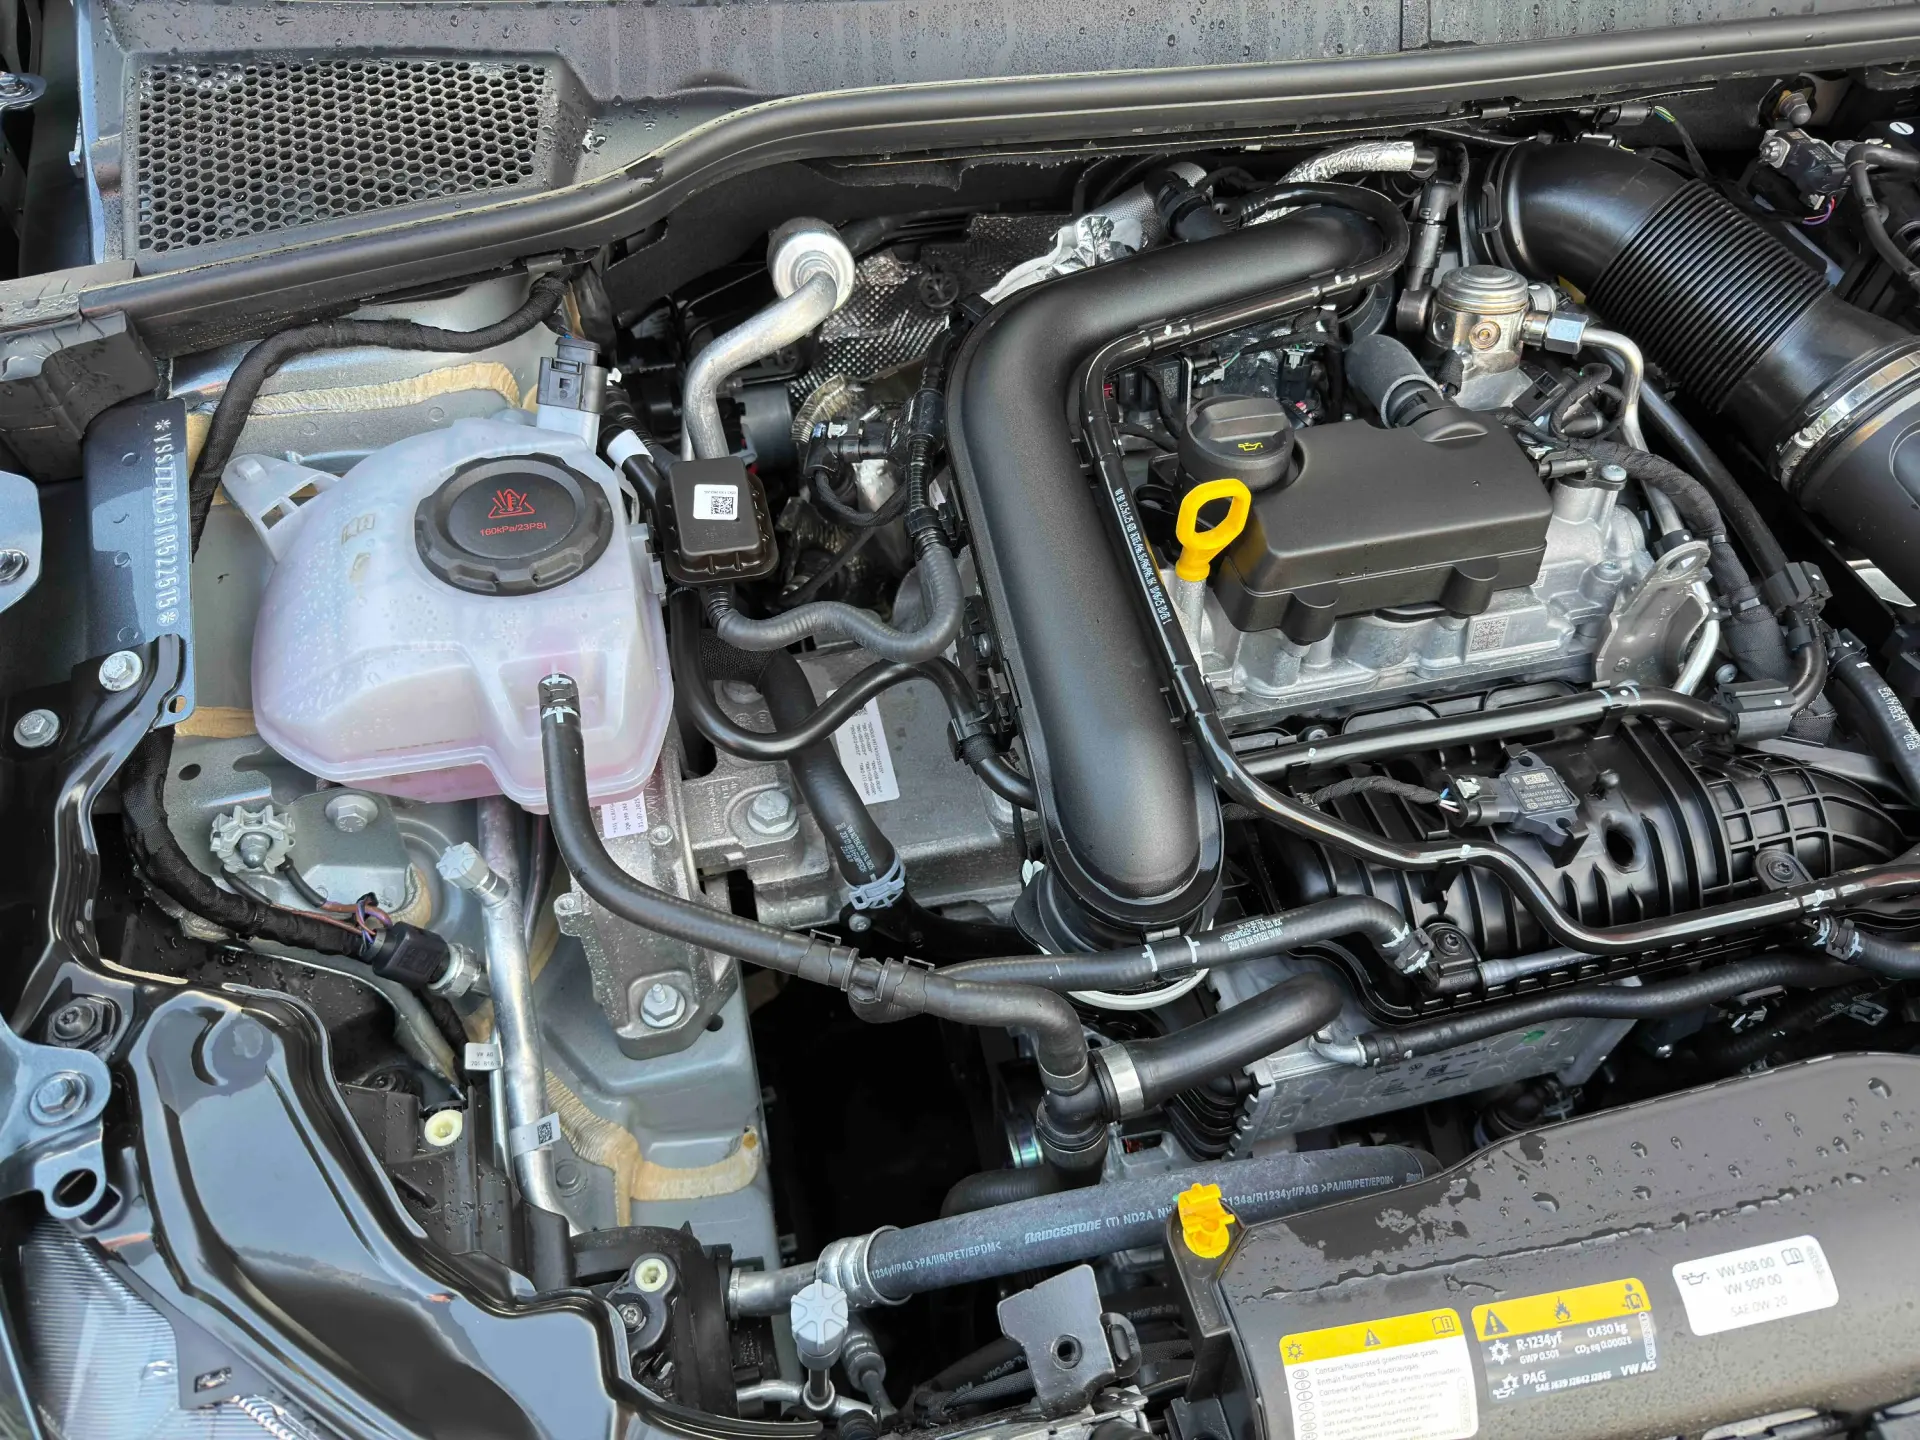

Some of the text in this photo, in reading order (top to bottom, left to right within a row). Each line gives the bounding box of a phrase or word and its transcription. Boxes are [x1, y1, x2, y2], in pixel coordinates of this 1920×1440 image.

[480, 522, 547, 536] 160kPa/23PSI
[1024, 1220, 1102, 1245] BRIDGESTONE
[1106, 1216, 1121, 1229] (T)
[1123, 1211, 1155, 1225] ND2A
[870, 1262, 914, 1280] 1234yf/PAG
[1716, 1256, 1776, 1278] VW 508 00
[1724, 1274, 1782, 1295] VW 509 00
[1614, 1320, 1628, 1335] kg
[1515, 1330, 1564, 1354] R-1234yf
[1519, 1352, 1538, 1365] GWP
[1620, 1360, 1657, 1376] VW AG
[1521, 1369, 1547, 1385] PAG
